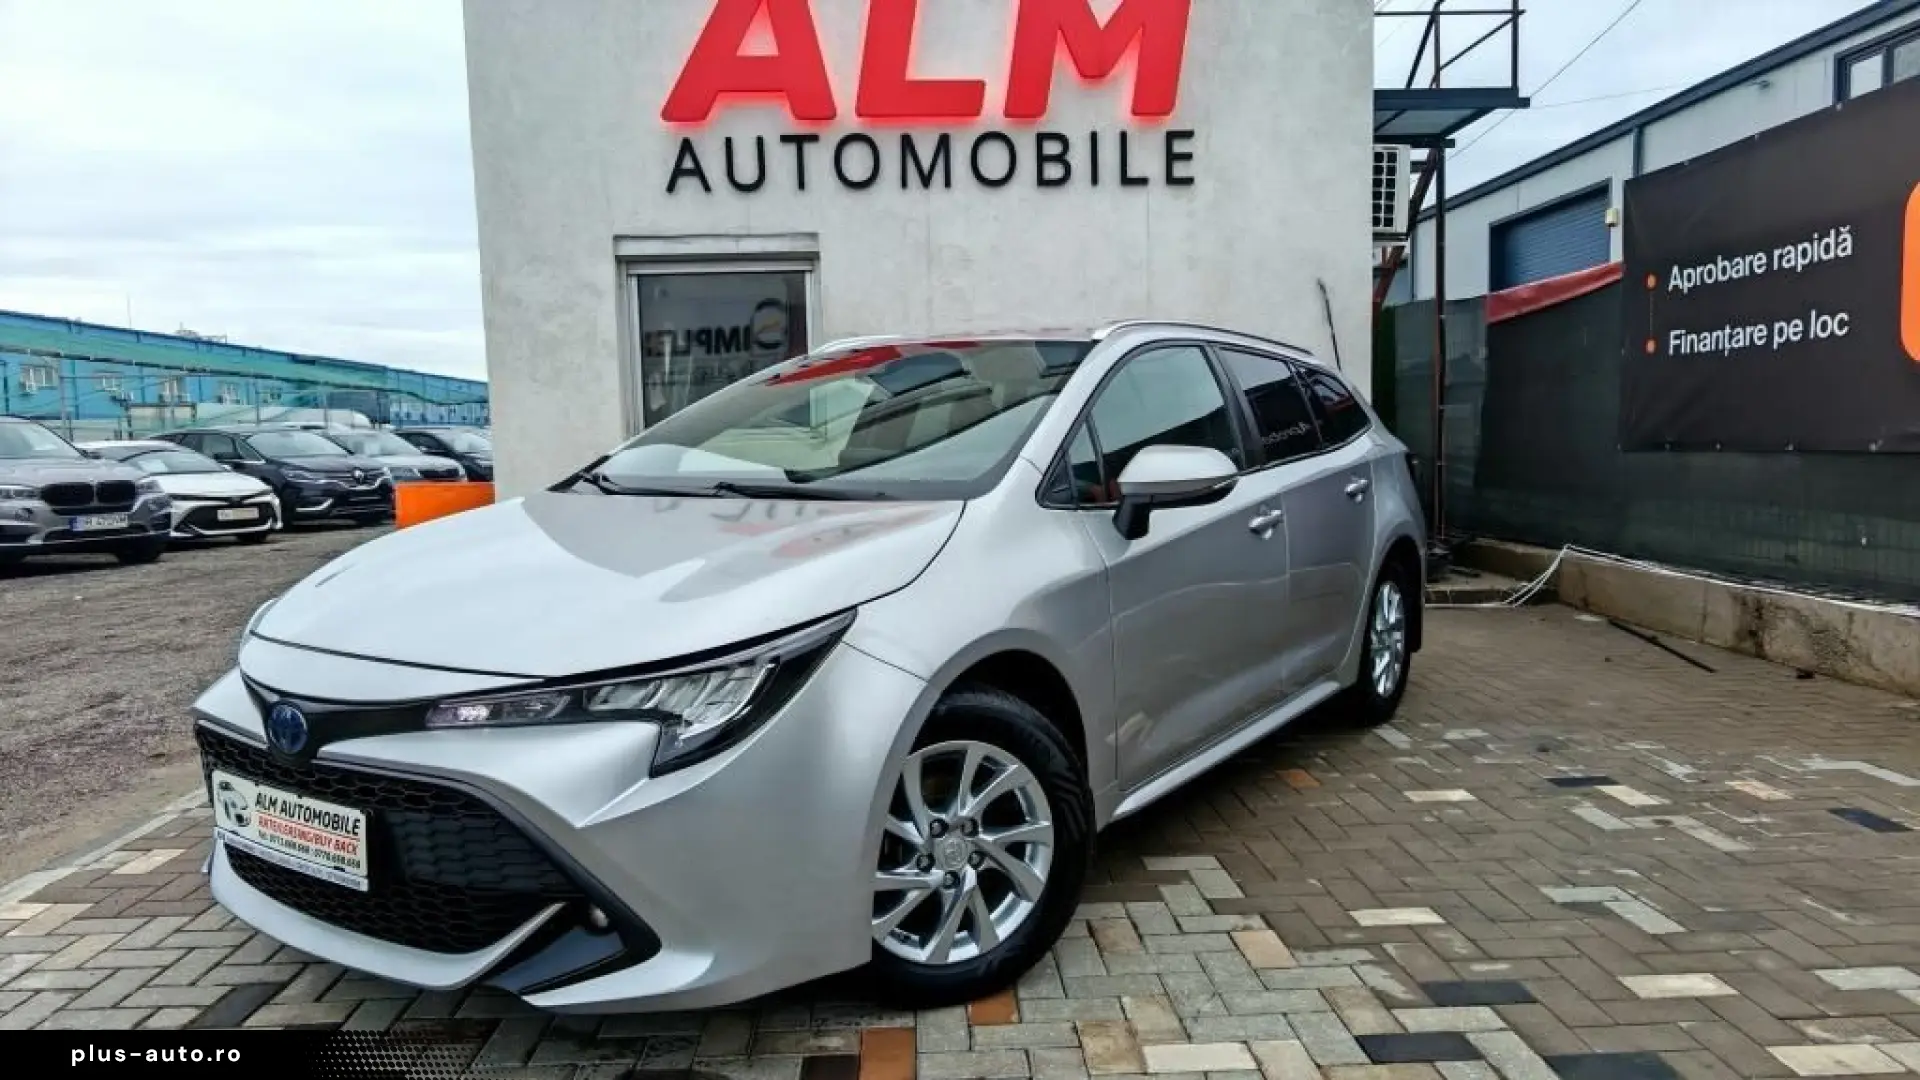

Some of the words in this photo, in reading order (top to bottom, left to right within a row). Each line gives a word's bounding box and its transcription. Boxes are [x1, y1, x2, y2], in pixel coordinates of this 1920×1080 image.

[661, 0, 1192, 121] ALM
[666, 129, 1195, 193] AUTOMOBILE
[1668, 251, 1768, 294] Aprobare
[1773, 225, 1852, 272] rapidă
[1668, 323, 1768, 357] Finanțare
[1773, 318, 1803, 350] pe
[1809, 309, 1850, 339] loc
[255, 792, 278, 812] ALM
[280, 798, 361, 836] AUTOMOBILE
[334, 838, 358, 855] BACK
